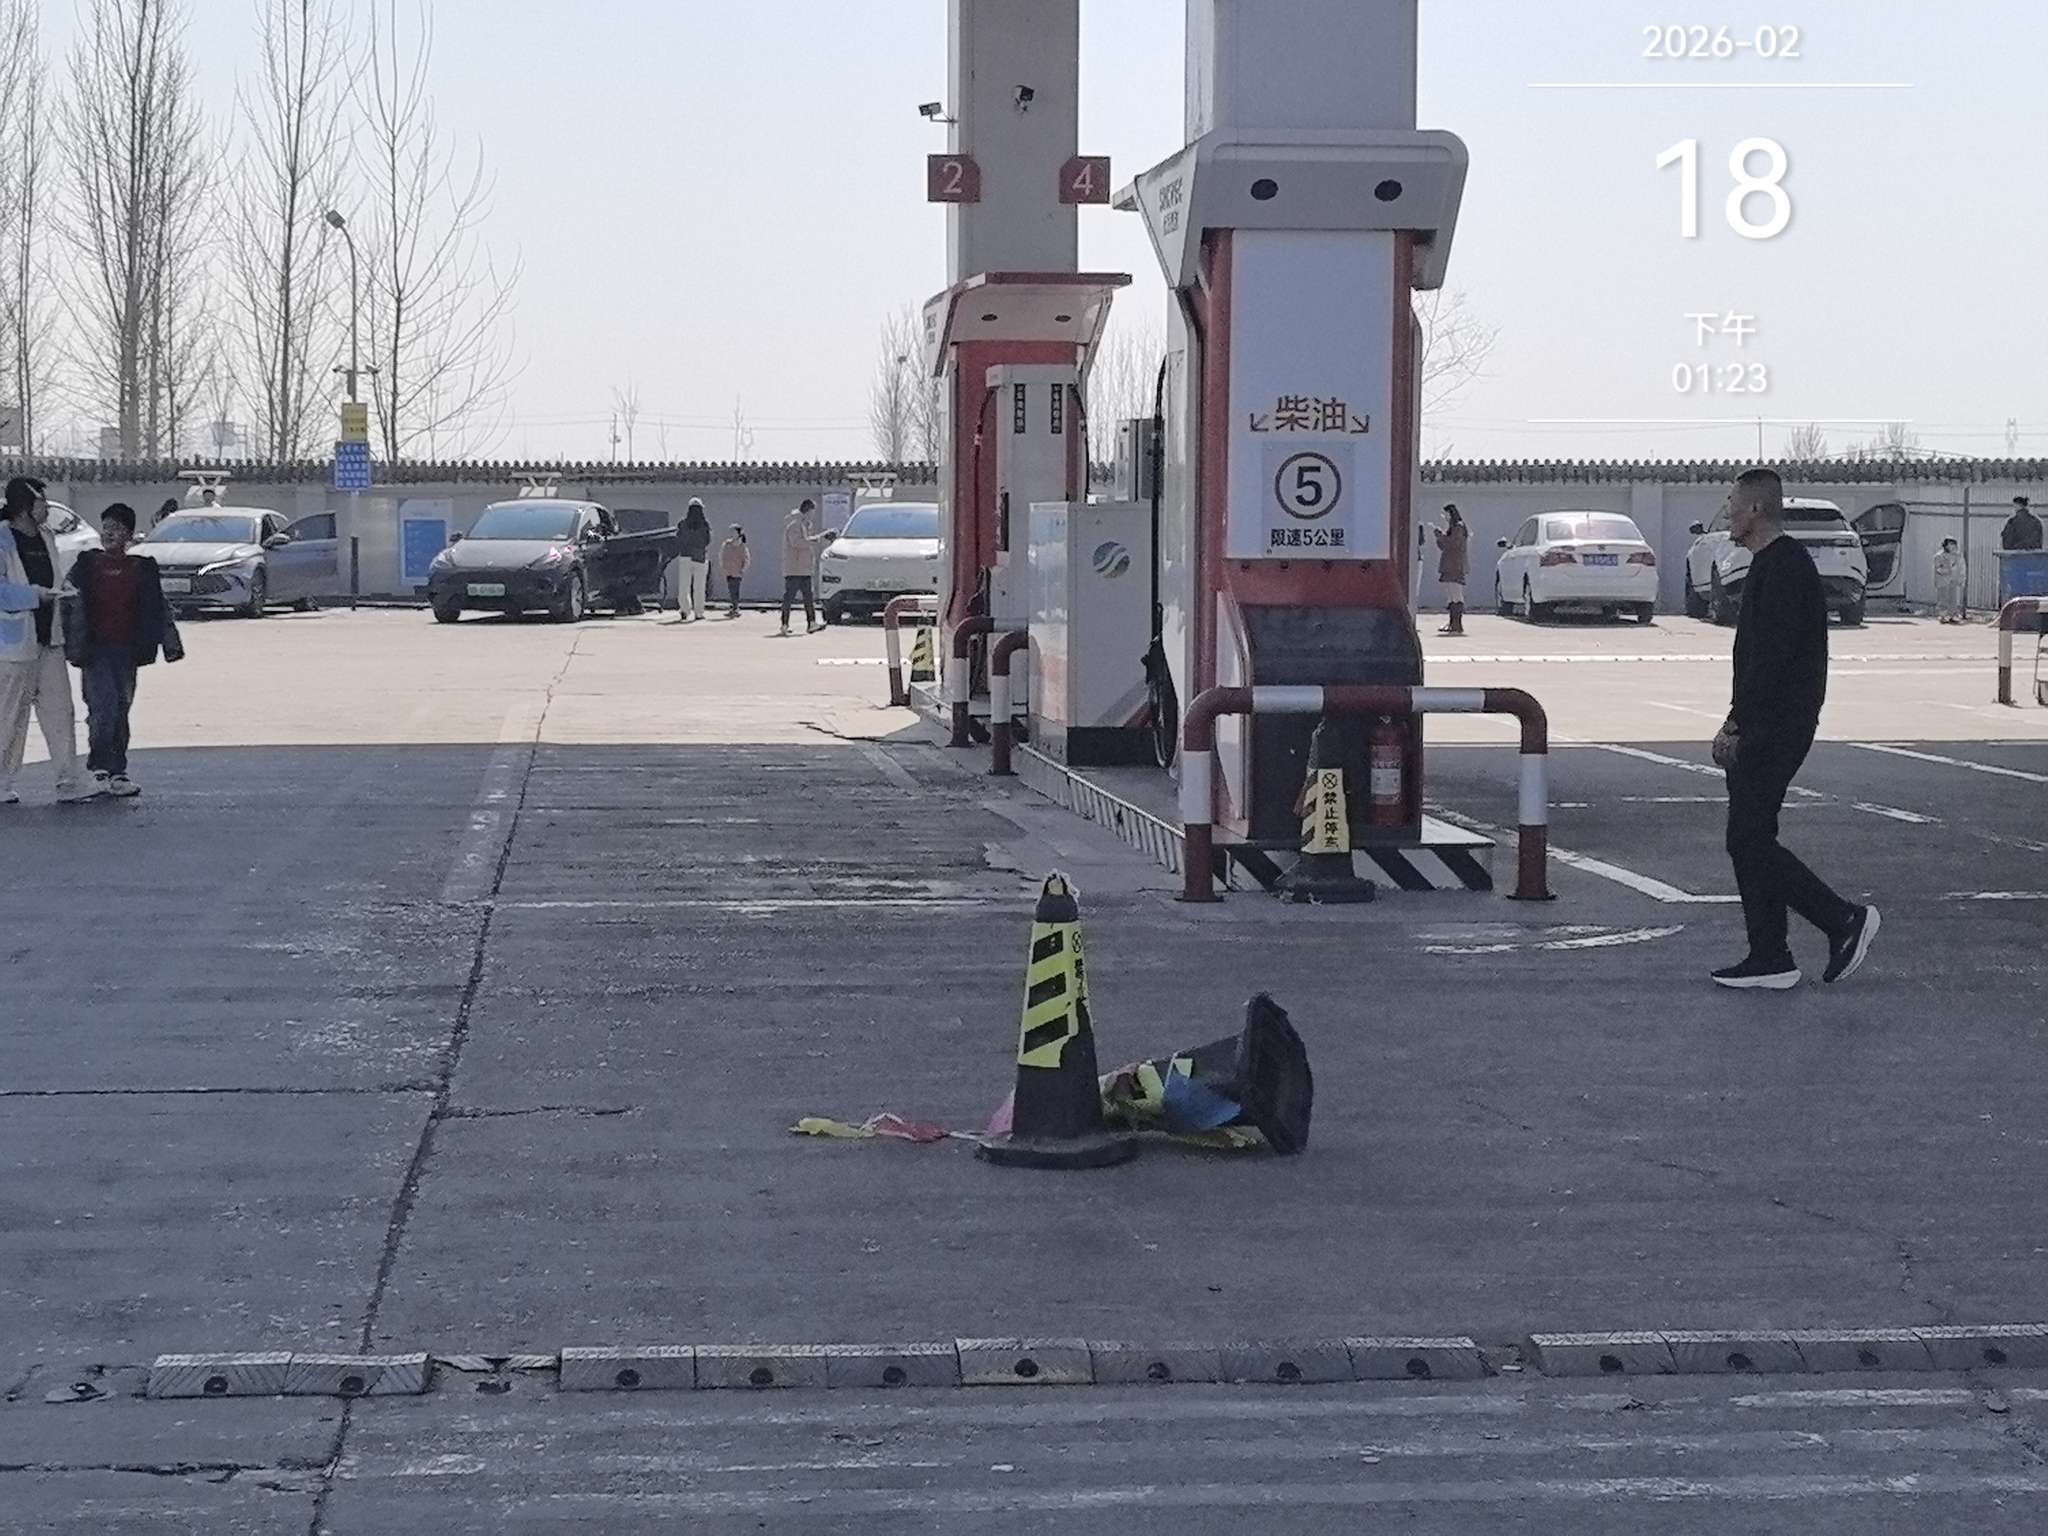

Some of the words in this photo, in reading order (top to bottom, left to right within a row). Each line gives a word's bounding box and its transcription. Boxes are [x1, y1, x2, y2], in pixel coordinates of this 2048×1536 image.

[943, 161, 963, 194] 2
[1072, 163, 1093, 195] 4
[1274, 394, 1347, 432] 柴油
[1295, 465, 1323, 507] 5
[1270, 527, 1346, 547] 限速5公里
